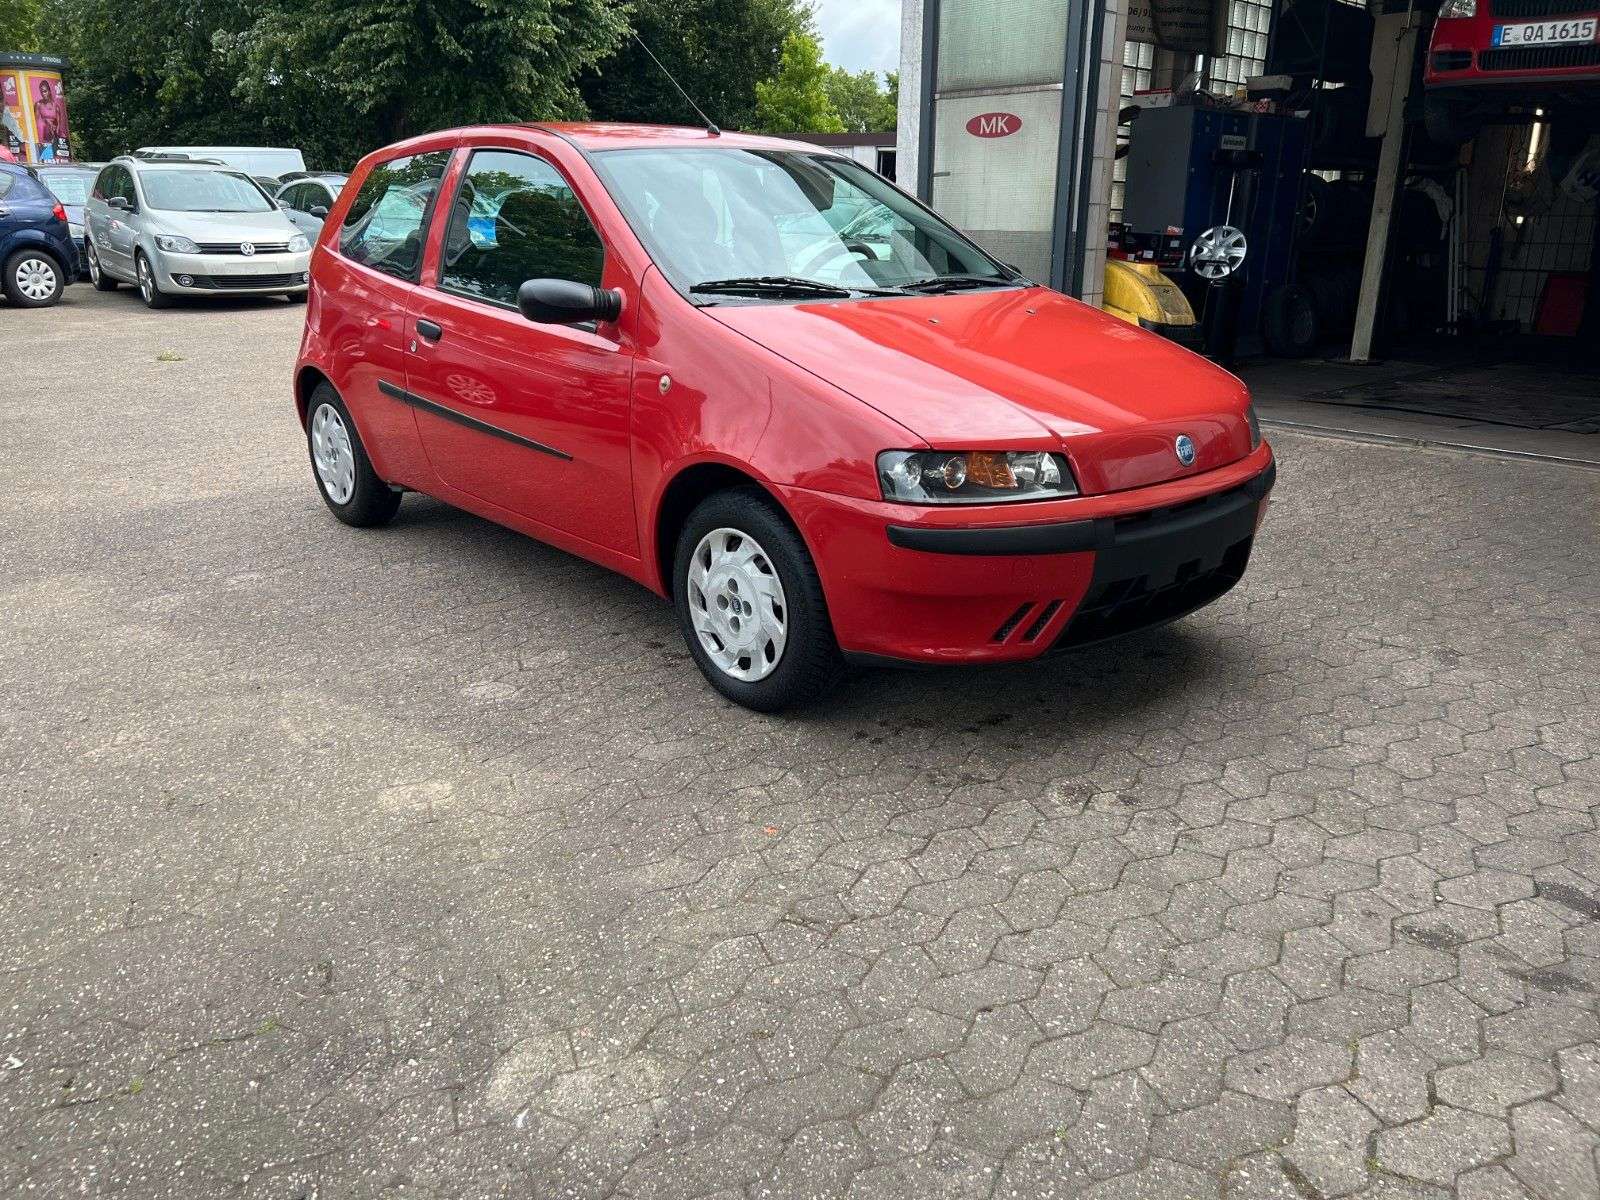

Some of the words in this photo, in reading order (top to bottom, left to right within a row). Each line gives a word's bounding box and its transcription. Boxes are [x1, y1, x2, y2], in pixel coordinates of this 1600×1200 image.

[1502, 27, 1513, 43] E
[1523, 25, 1544, 41] QA
[1547, 21, 1593, 40] 1615
[980, 116, 1009, 134] MK
